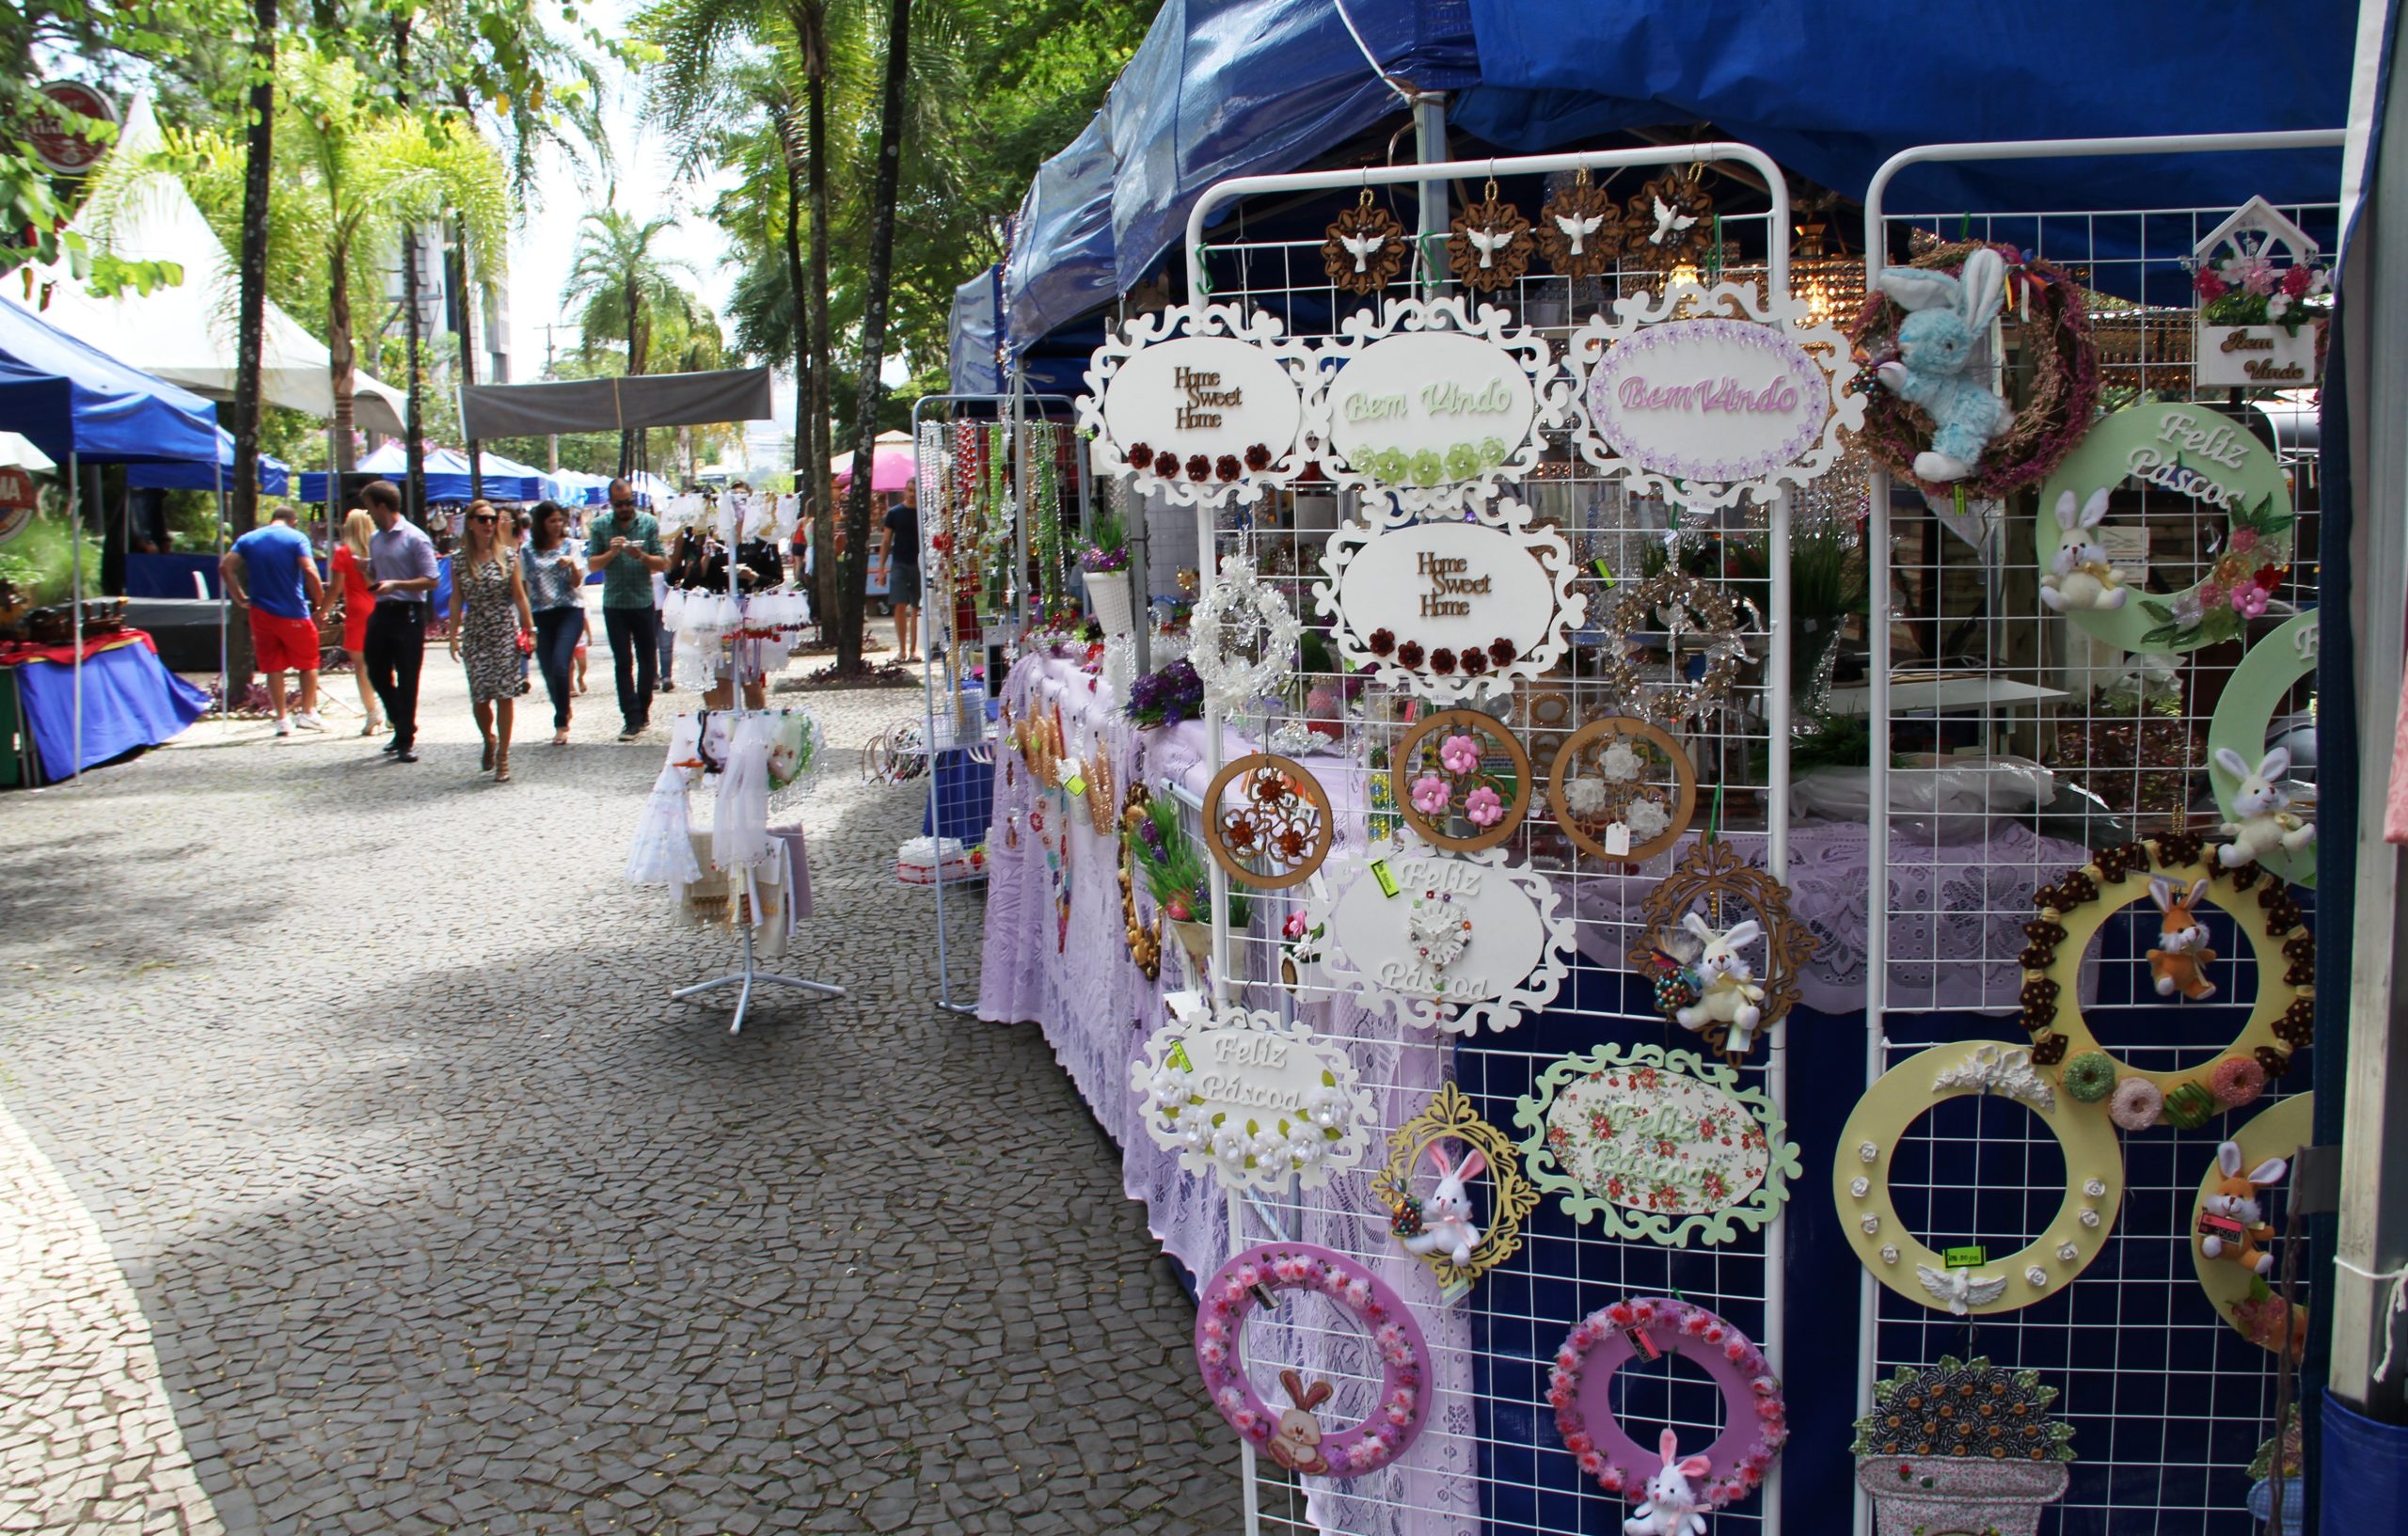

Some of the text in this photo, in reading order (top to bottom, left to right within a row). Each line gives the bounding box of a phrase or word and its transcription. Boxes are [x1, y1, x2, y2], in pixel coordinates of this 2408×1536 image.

[1174, 366, 1221, 388] Home
[1618, 374, 1798, 413] Bem Vindo
[1186, 387, 1243, 409] Sweet
[1343, 376, 1513, 423] Bem Vindo
[1175, 406, 1223, 430] Home
[2157, 411, 2251, 469] Feliz
[1417, 551, 1468, 576] Home
[1430, 573, 1492, 597] Sweet
[1418, 594, 1471, 617] Home
[1401, 857, 1483, 896] Feliz
[1213, 1034, 1289, 1069] Feliz
[1201, 1073, 1302, 1112] Páscoa
[1608, 1102, 1699, 1142] Feliz
[1590, 1143, 1706, 1189] Páscoa
